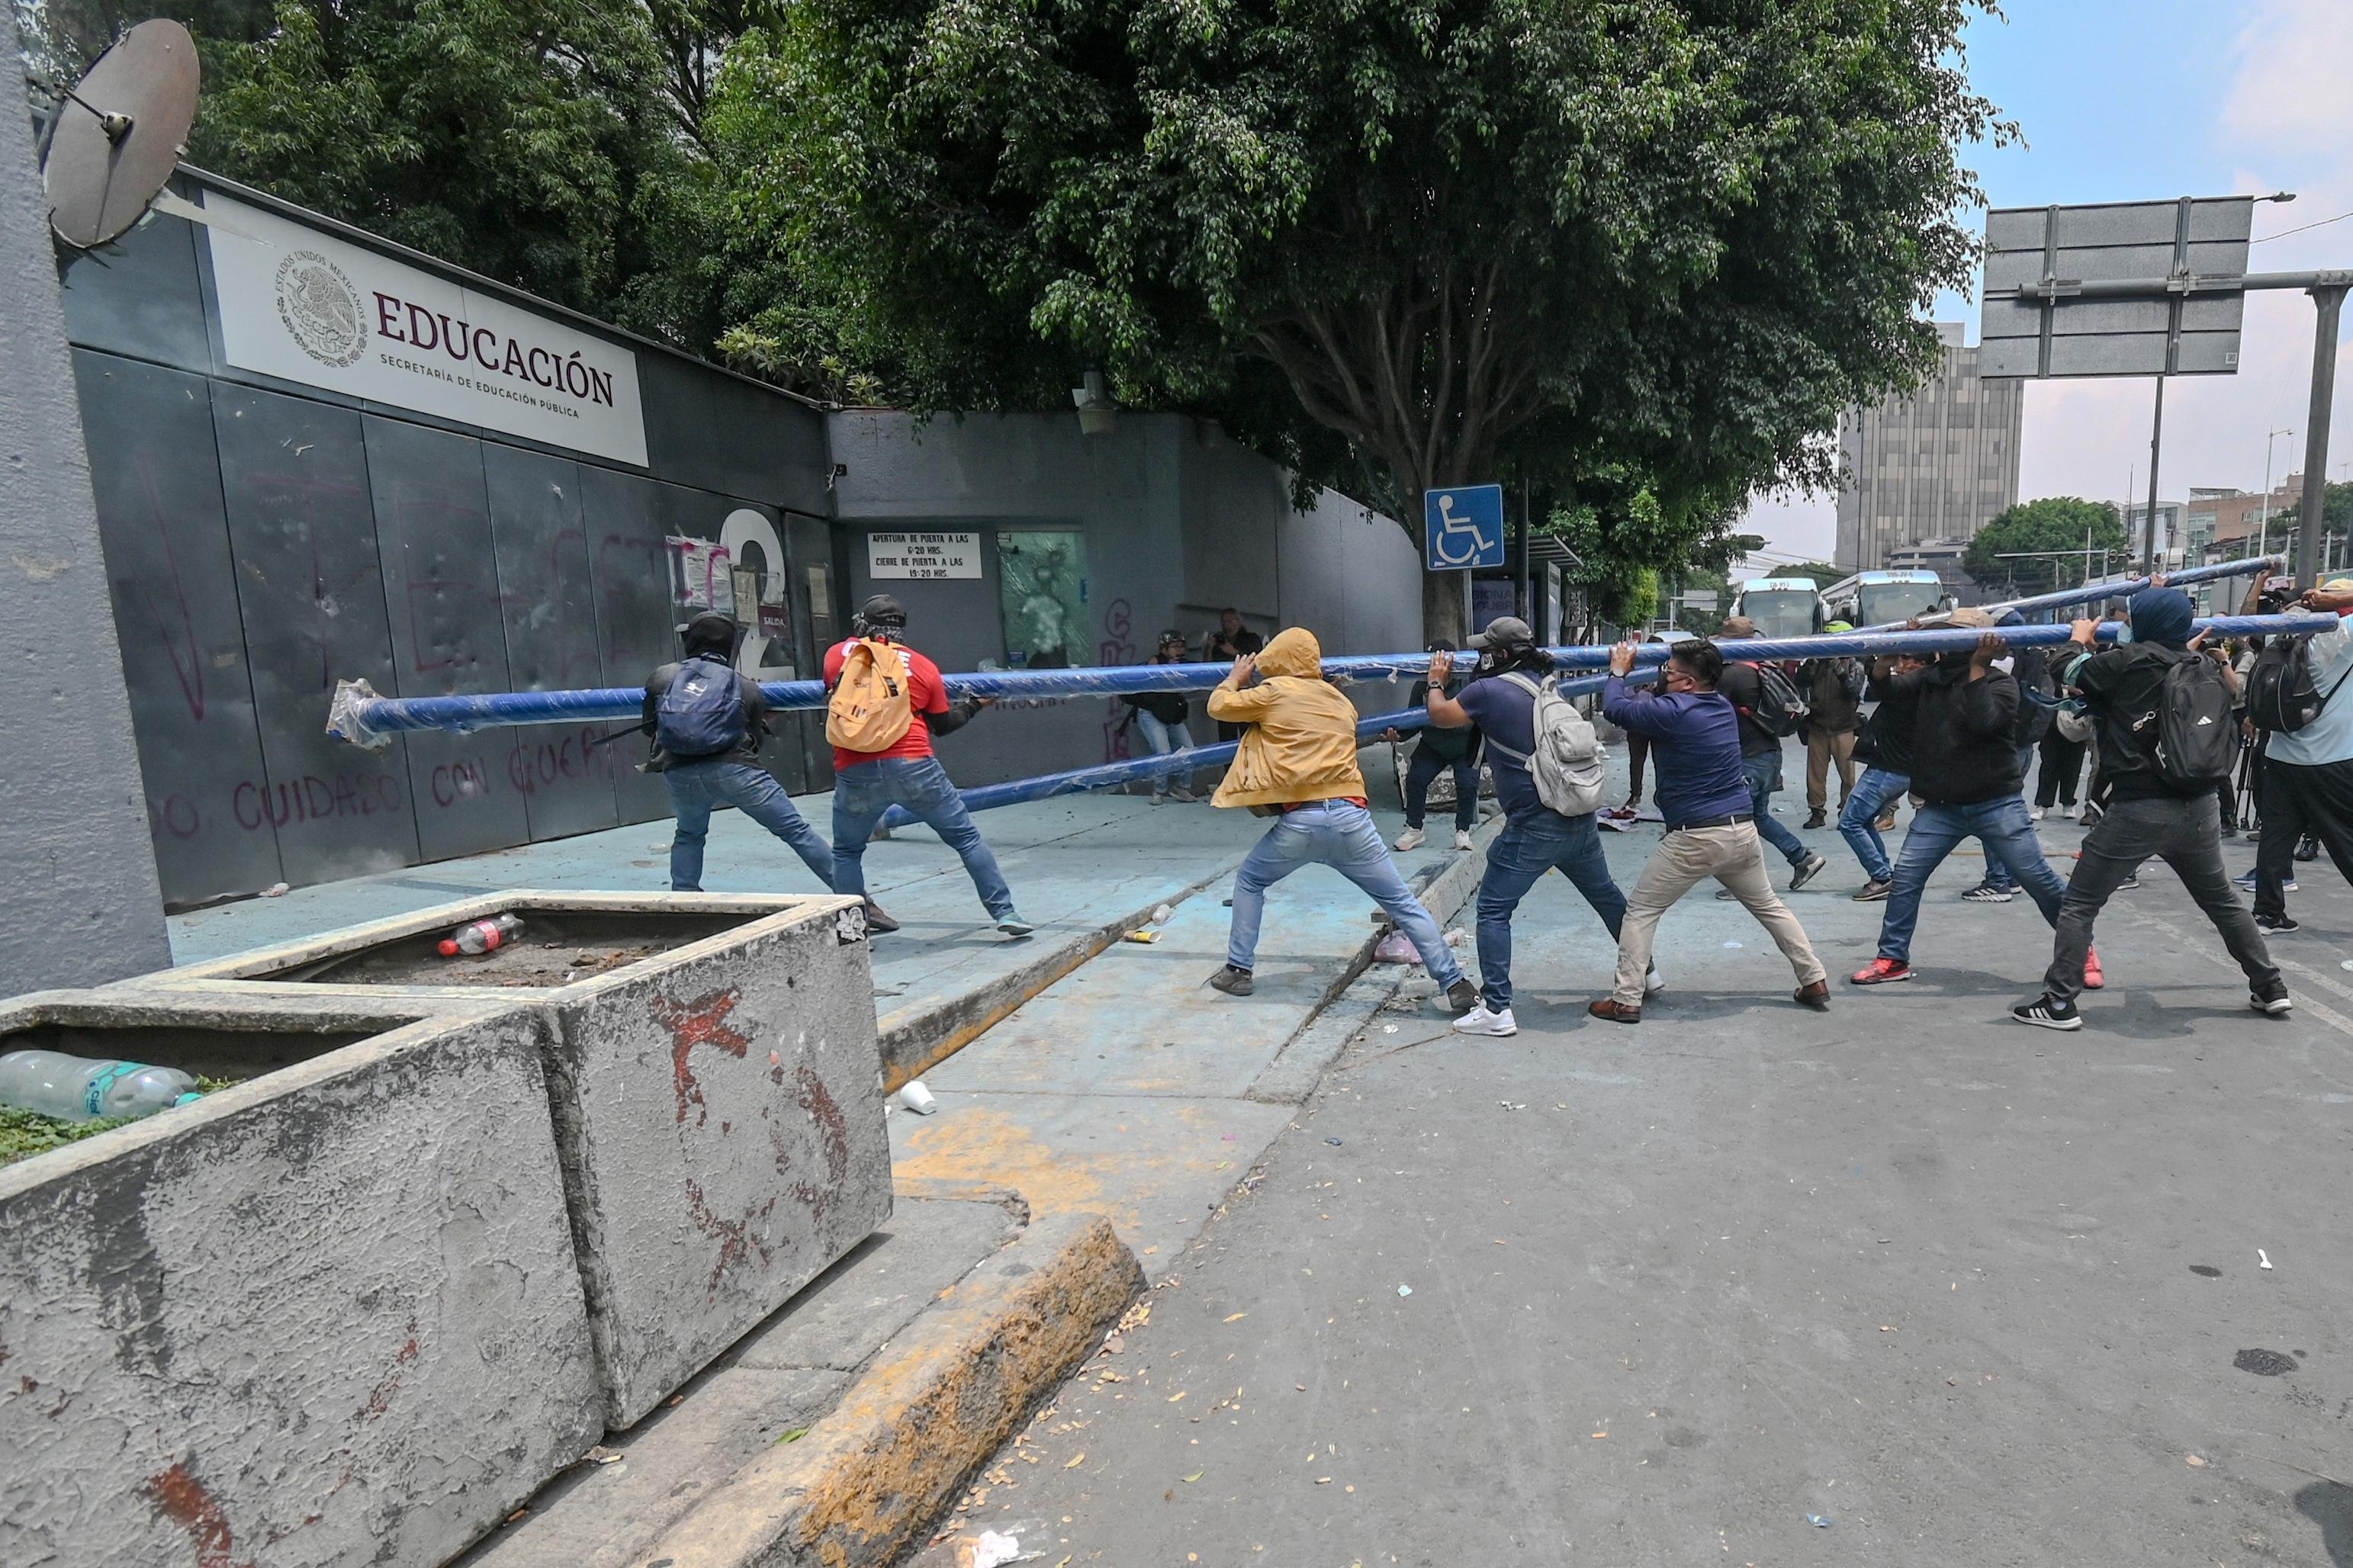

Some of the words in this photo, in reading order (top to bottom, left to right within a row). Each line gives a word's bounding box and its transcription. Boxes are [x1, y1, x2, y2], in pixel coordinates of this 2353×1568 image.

[275, 255, 295, 293] ESTADOS
[294, 250, 326, 266] UNIDOS
[329, 262, 366, 320] MEXICANOS
[373, 291, 613, 408] EDUCACIÓN
[380, 353, 454, 383] SECRETARÍA
[458, 376, 472, 388] DE
[476, 381, 536, 406] EDUCACIÓN
[540, 400, 580, 419] PÚBLICA
[873, 535, 906, 543] APERTURA
[910, 535, 918, 543] DE
[921, 535, 944, 543] PUERTA
[948, 535, 953, 543] A
[956, 535, 969, 543] LAS
[876, 557, 898, 566] CIERRE
[902, 557, 908, 566] DE
[912, 557, 937, 566] PUERTA
[927, 546, 943, 554] HRS.
[233, 772, 403, 831] CUIDADO
[432, 755, 489, 808] CON
